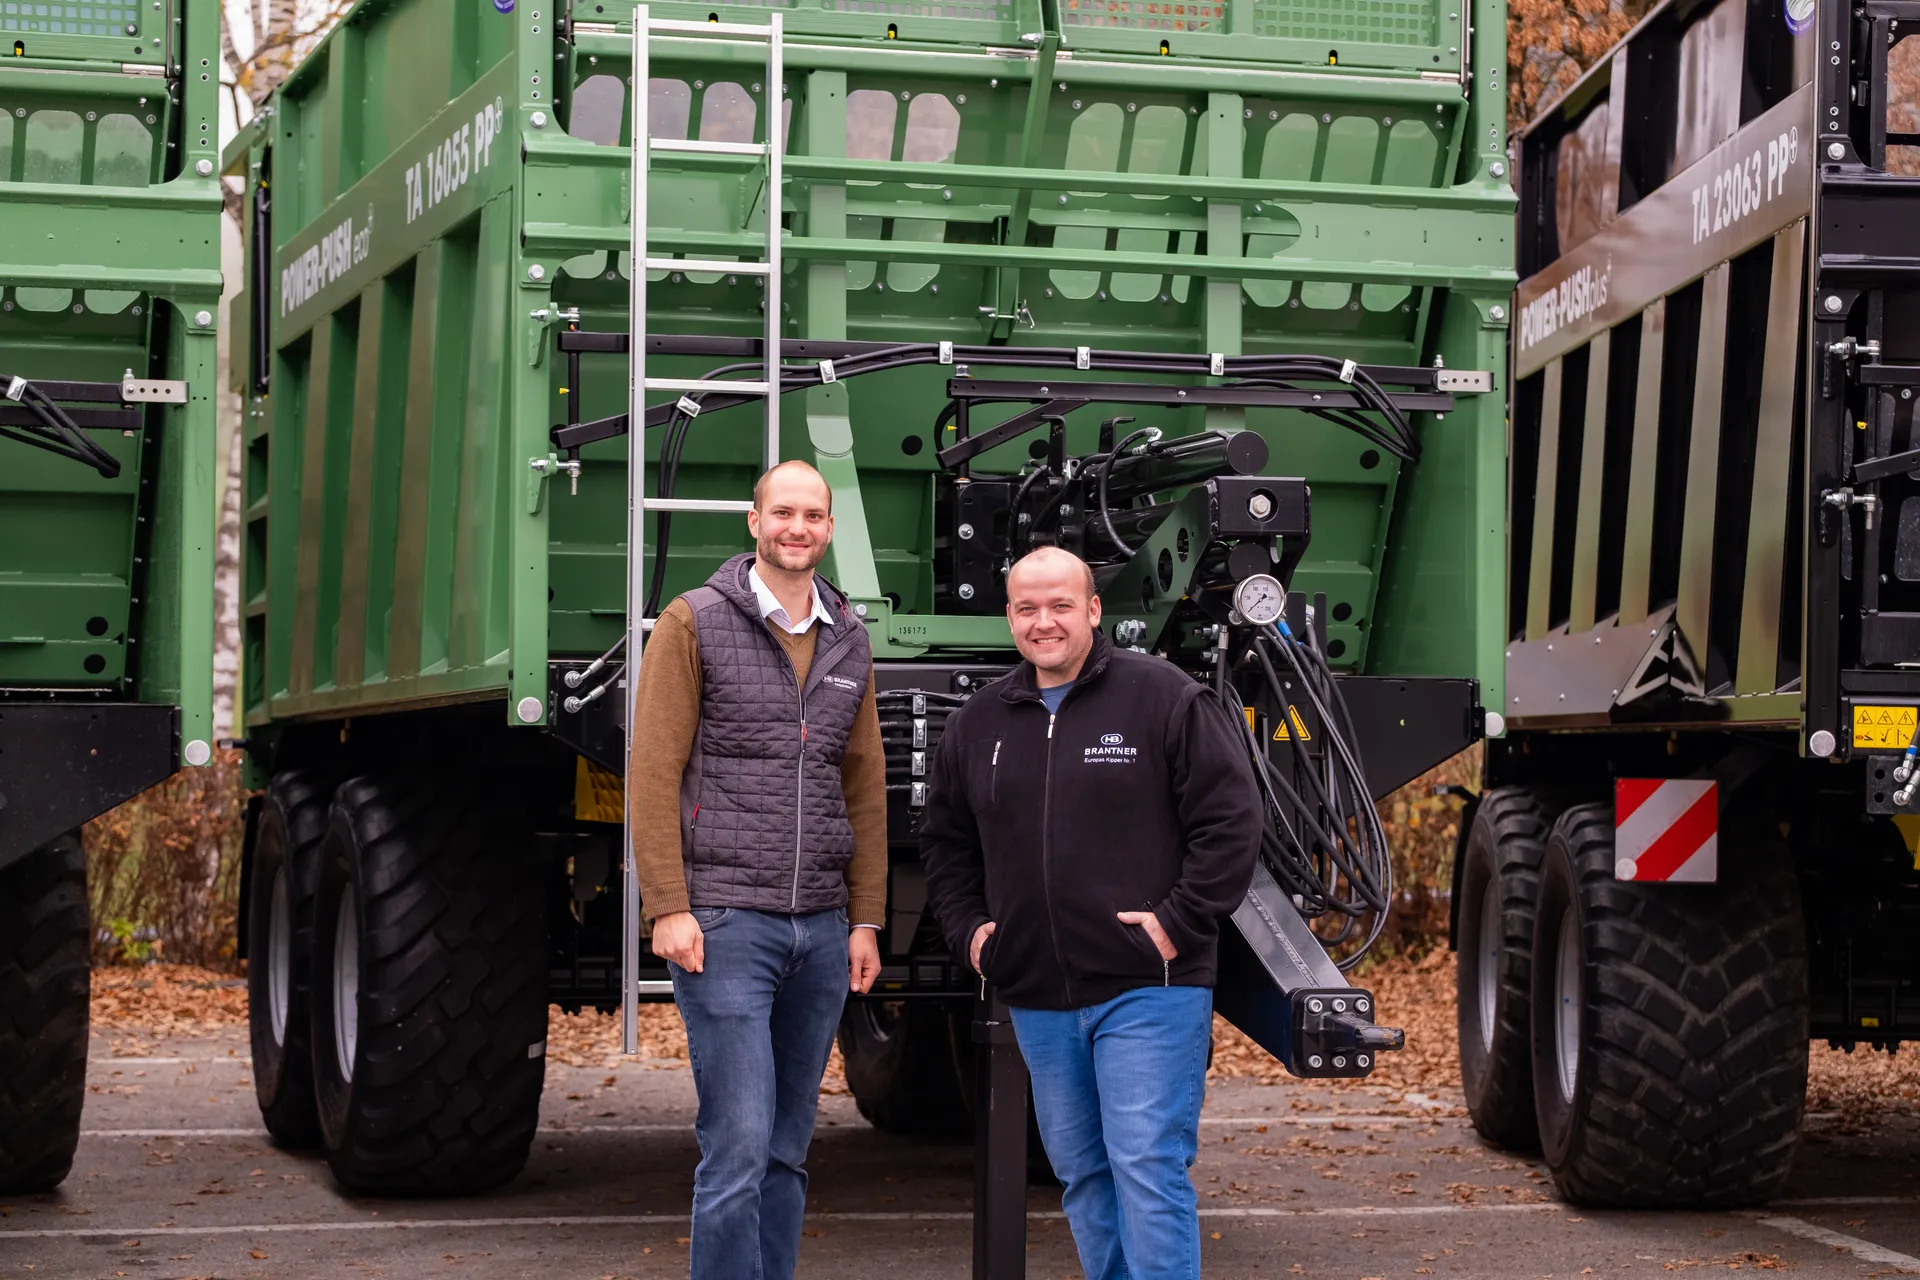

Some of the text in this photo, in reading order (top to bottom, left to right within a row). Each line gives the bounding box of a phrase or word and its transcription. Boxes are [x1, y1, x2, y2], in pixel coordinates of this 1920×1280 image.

[405, 161, 423, 225] TA
[427, 122, 470, 209] 16055
[1692, 183, 1710, 245] TA
[1713, 149, 1762, 234] 23063
[281, 217, 369, 318] POWER-PUSH eco
[1521, 264, 1608, 351] POWER-PUSH plus
[899, 626, 927, 635] 136173
[1084, 747, 1137, 756] BRANTNER
